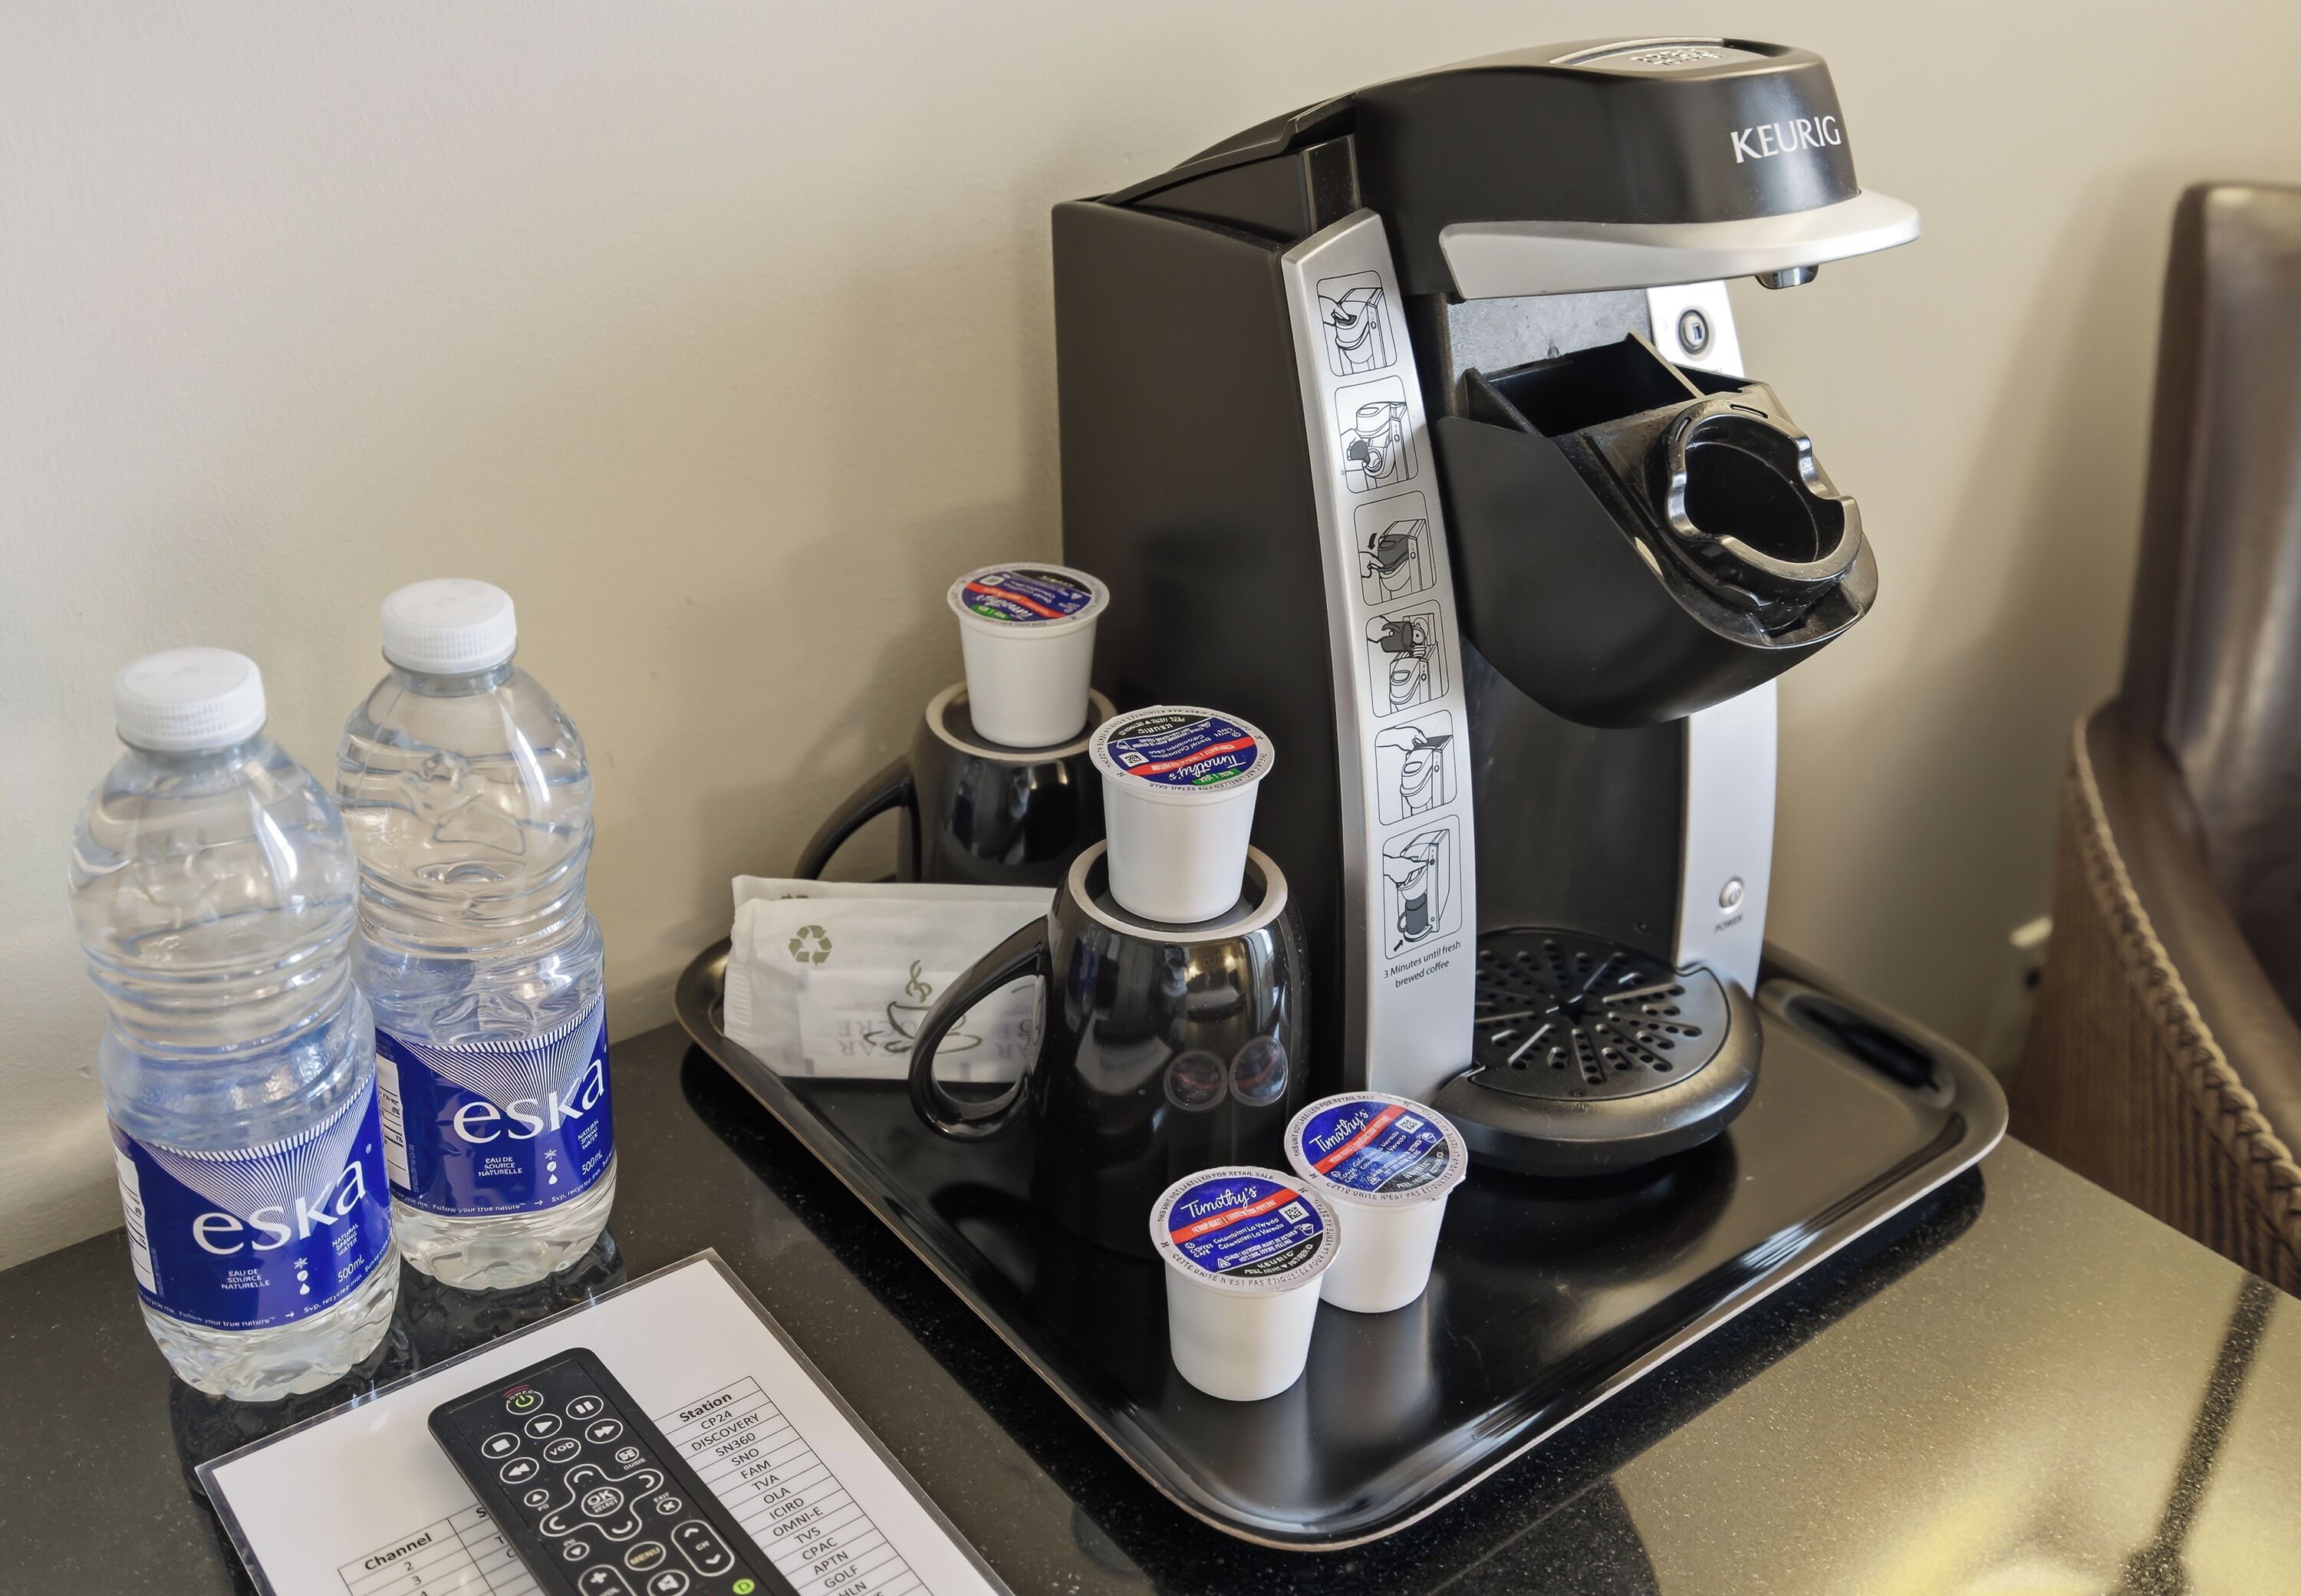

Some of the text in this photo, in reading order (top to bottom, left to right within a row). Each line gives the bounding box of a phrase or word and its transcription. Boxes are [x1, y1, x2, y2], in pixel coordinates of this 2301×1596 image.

[1730, 115, 1842, 164] KEURIG
[1384, 940, 1461, 979] 3 Minutes until fresh
[1395, 960, 1450, 989] brewed coffee
[453, 1058, 604, 1143] eska
[1309, 1108, 1368, 1153] Timothy's
[193, 1160, 367, 1255] eska
[1180, 1186, 1257, 1218] Timothy's
[679, 1394, 732, 1422] Station
[701, 1410, 732, 1430] CP24
[691, 1413, 760, 1451] DISCOVERY
[549, 1442, 574, 1456] VOD
[716, 1433, 755, 1456] SN360
[732, 1448, 759, 1466] SNO
[740, 1459, 771, 1479] FAM
[751, 1474, 780, 1490] TVA
[587, 1489, 614, 1506] OK
[653, 1492, 670, 1503] EXIT
[763, 1487, 791, 1504] OLA
[769, 1498, 804, 1520] ICIRD
[773, 1506, 823, 1536] OMNI-E
[364, 1532, 433, 1571] Channel
[630, 1547, 660, 1565] MENU
[802, 1537, 838, 1560] CPAC
[404, 1561, 414, 1571] 2
[813, 1551, 848, 1575] APTN
[413, 1575, 422, 1585] 3
[738, 1582, 750, 1591] D
[825, 1565, 858, 1588] GOLF
[838, 1581, 867, 1596] HLN
